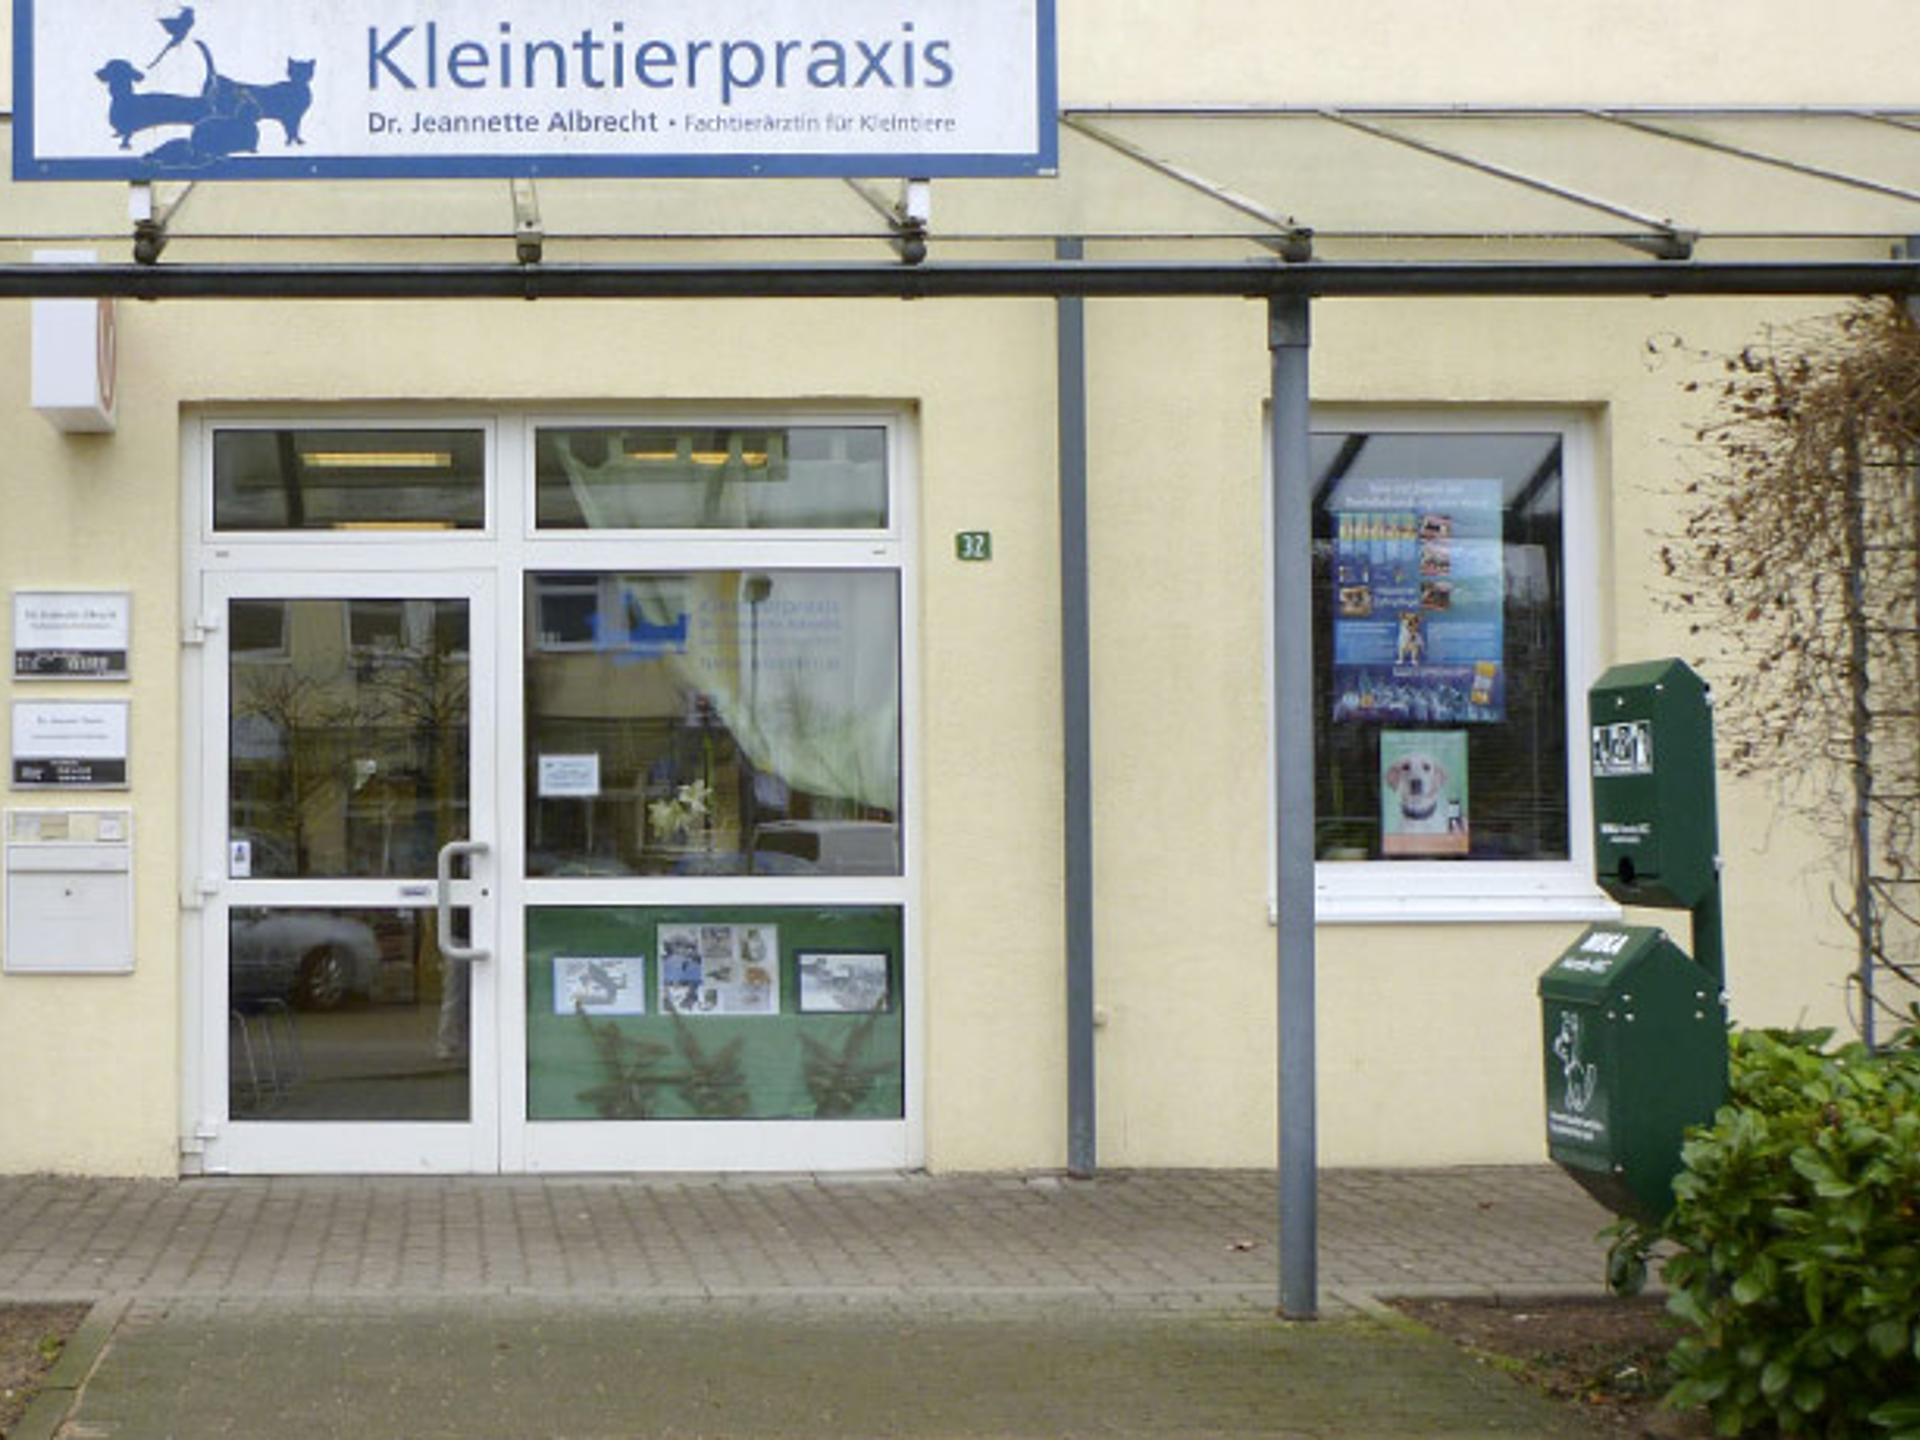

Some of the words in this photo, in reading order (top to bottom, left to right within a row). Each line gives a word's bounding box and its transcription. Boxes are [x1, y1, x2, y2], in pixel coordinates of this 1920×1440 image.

[367, 21, 954, 106] Kleintierpraxis
[368, 113, 403, 133] Dr.
[410, 112, 540, 133] Jeannette
[547, 111, 658, 133] Albrecht
[826, 113, 852, 132] für
[860, 114, 956, 132] Kleintiere
